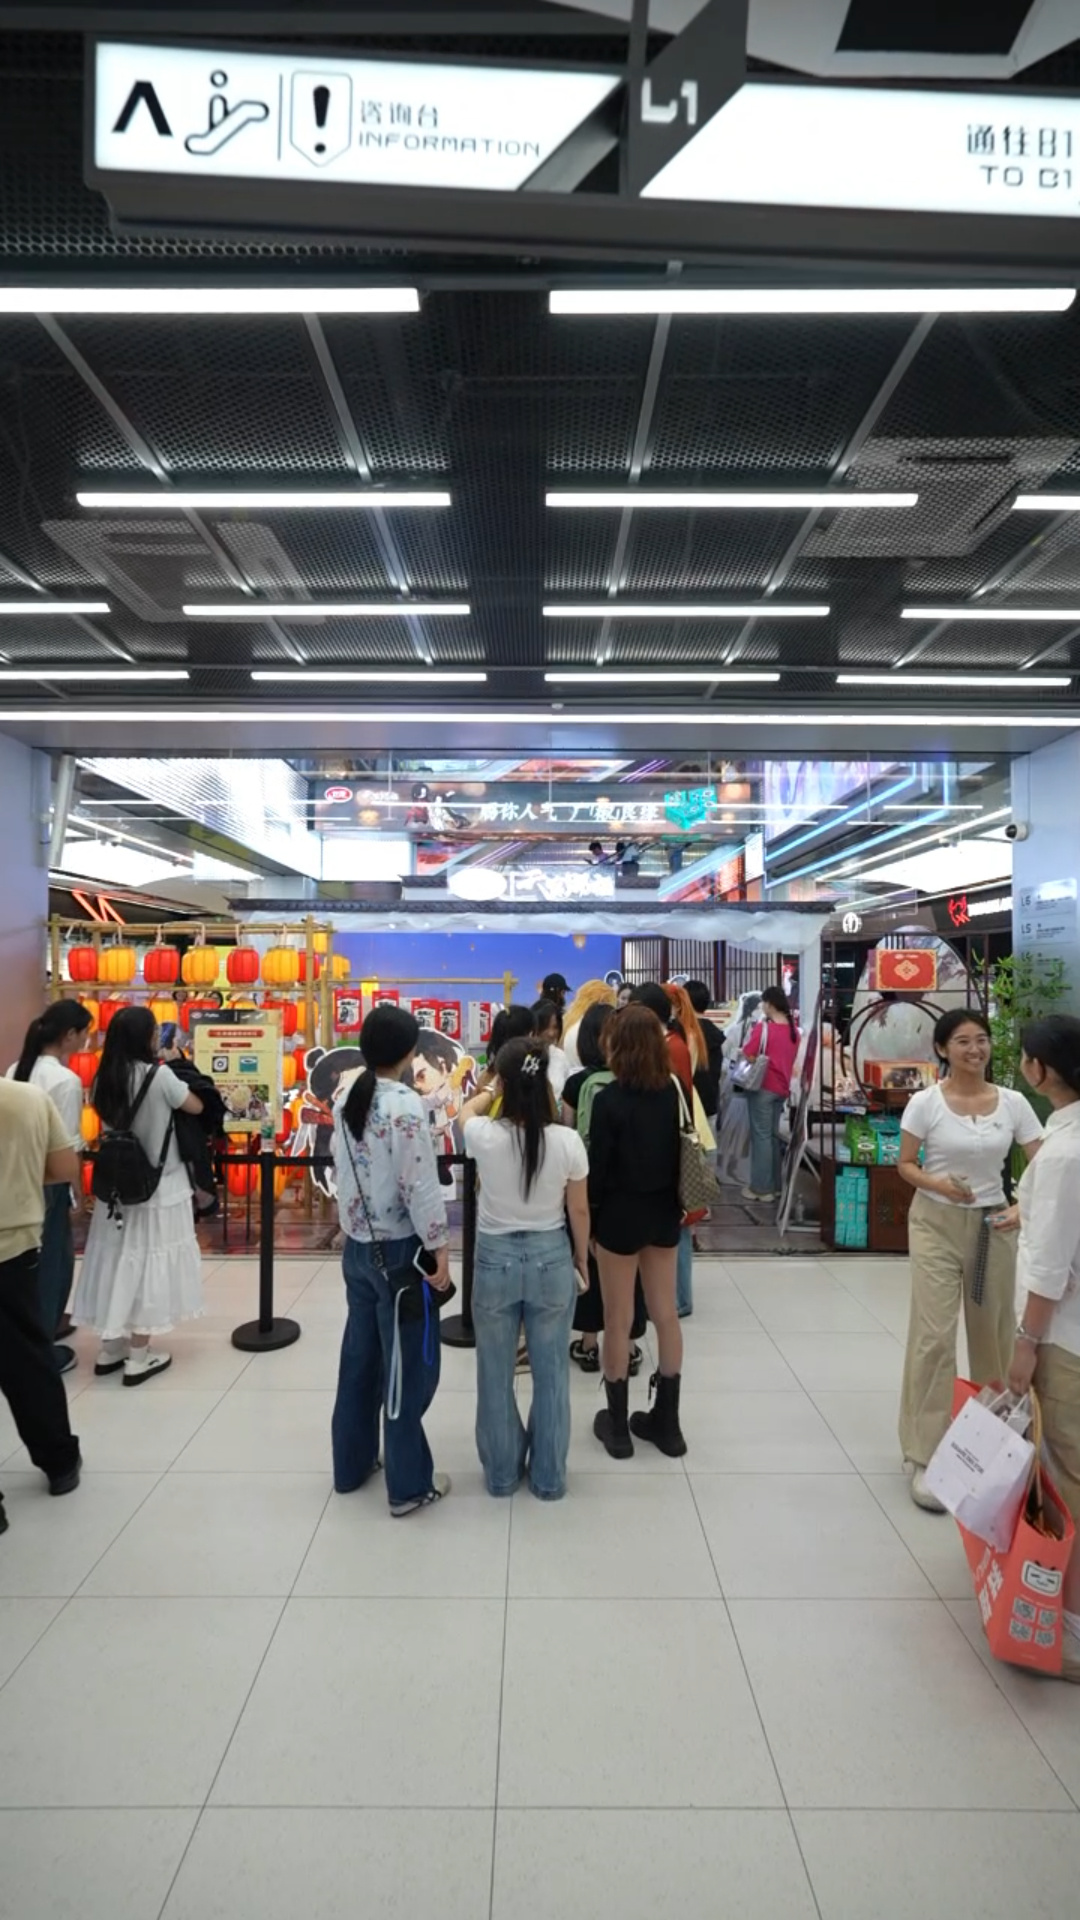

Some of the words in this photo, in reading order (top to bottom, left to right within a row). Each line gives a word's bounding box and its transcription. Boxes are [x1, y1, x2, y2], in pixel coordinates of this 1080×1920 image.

[360, 99, 439, 128] 咨询台
[640, 77, 699, 126] L1
[358, 130, 541, 159] INFORMATION
[980, 164, 1024, 187] TO
[1038, 166, 1073, 190] B1
